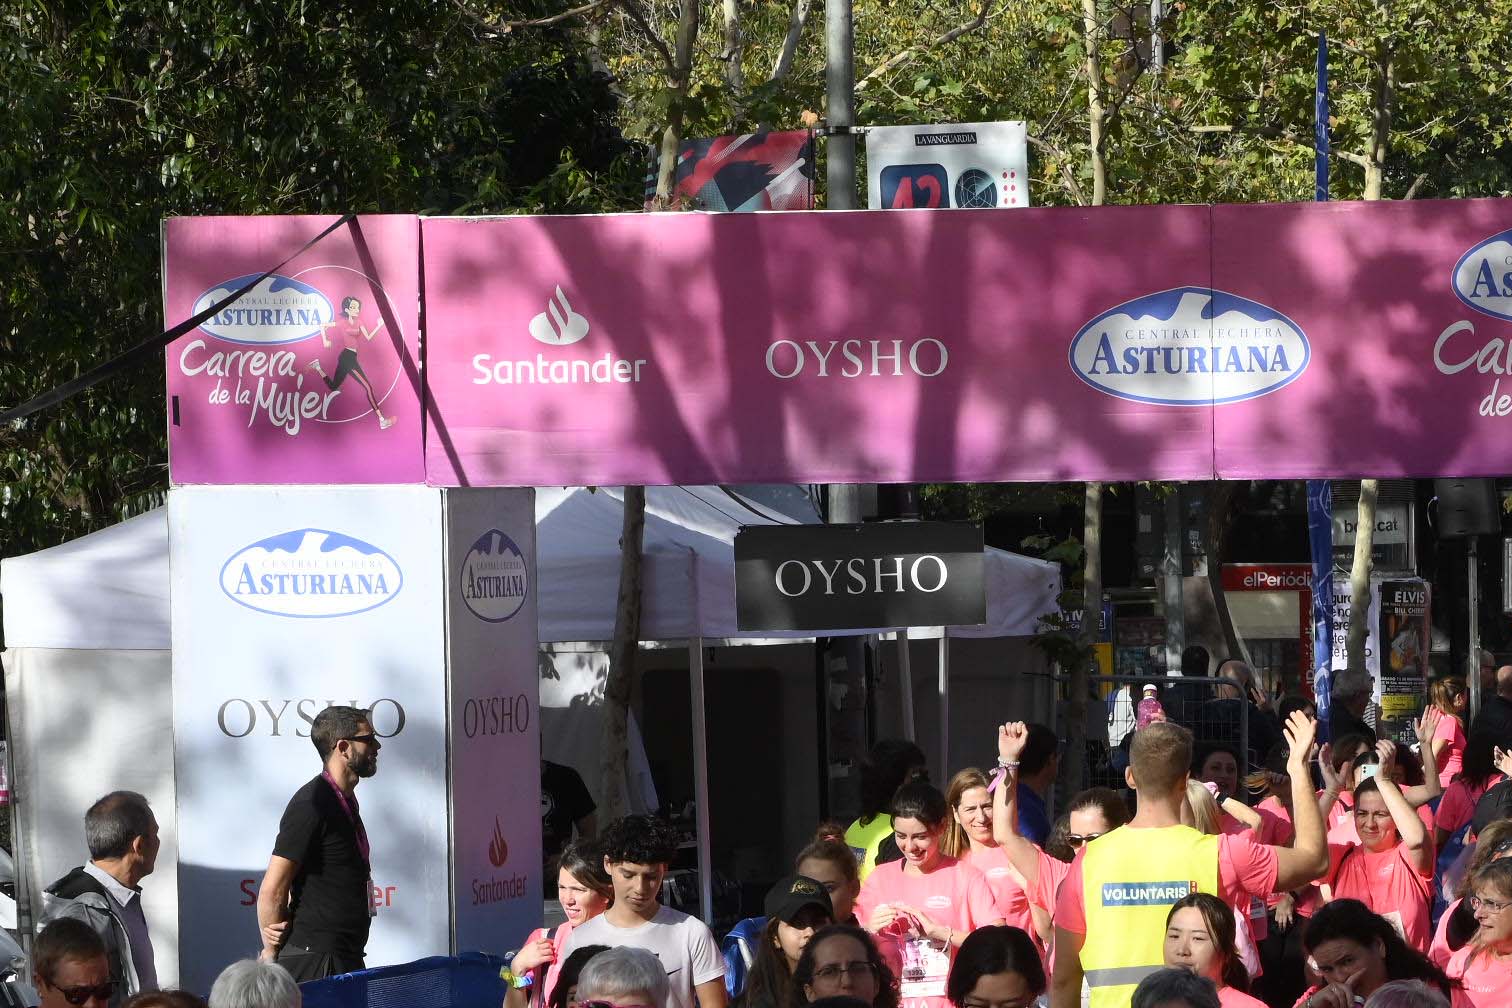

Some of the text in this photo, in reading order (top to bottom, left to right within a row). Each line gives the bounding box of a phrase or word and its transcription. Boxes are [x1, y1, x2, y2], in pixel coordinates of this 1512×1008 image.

[917, 133, 976, 144] LA VANGUARDIA
[203, 299, 322, 326] ASTURIANA
[1125, 329, 1200, 340] CENTRAL
[180, 340, 297, 377] Carrera
[472, 352, 646, 384] Santander
[766, 338, 948, 379] OYSHO
[1088, 332, 1291, 375] ASTURIANA
[208, 378, 250, 404] de la
[248, 375, 341, 435] Mujer
[1479, 378, 1512, 417] de
[234, 563, 390, 595] ASTURIANA
[466, 565, 523, 599] ASTURIANA
[775, 555, 948, 596] OYSHO
[1244, 571, 1313, 587] elPeriódi
[1394, 591, 1425, 603] ELVIS
[217, 698, 406, 738] OYSO
[463, 694, 529, 739] OYSHO
[472, 874, 527, 906] Santander
[1103, 886, 1187, 900] VOLUNTARIS
